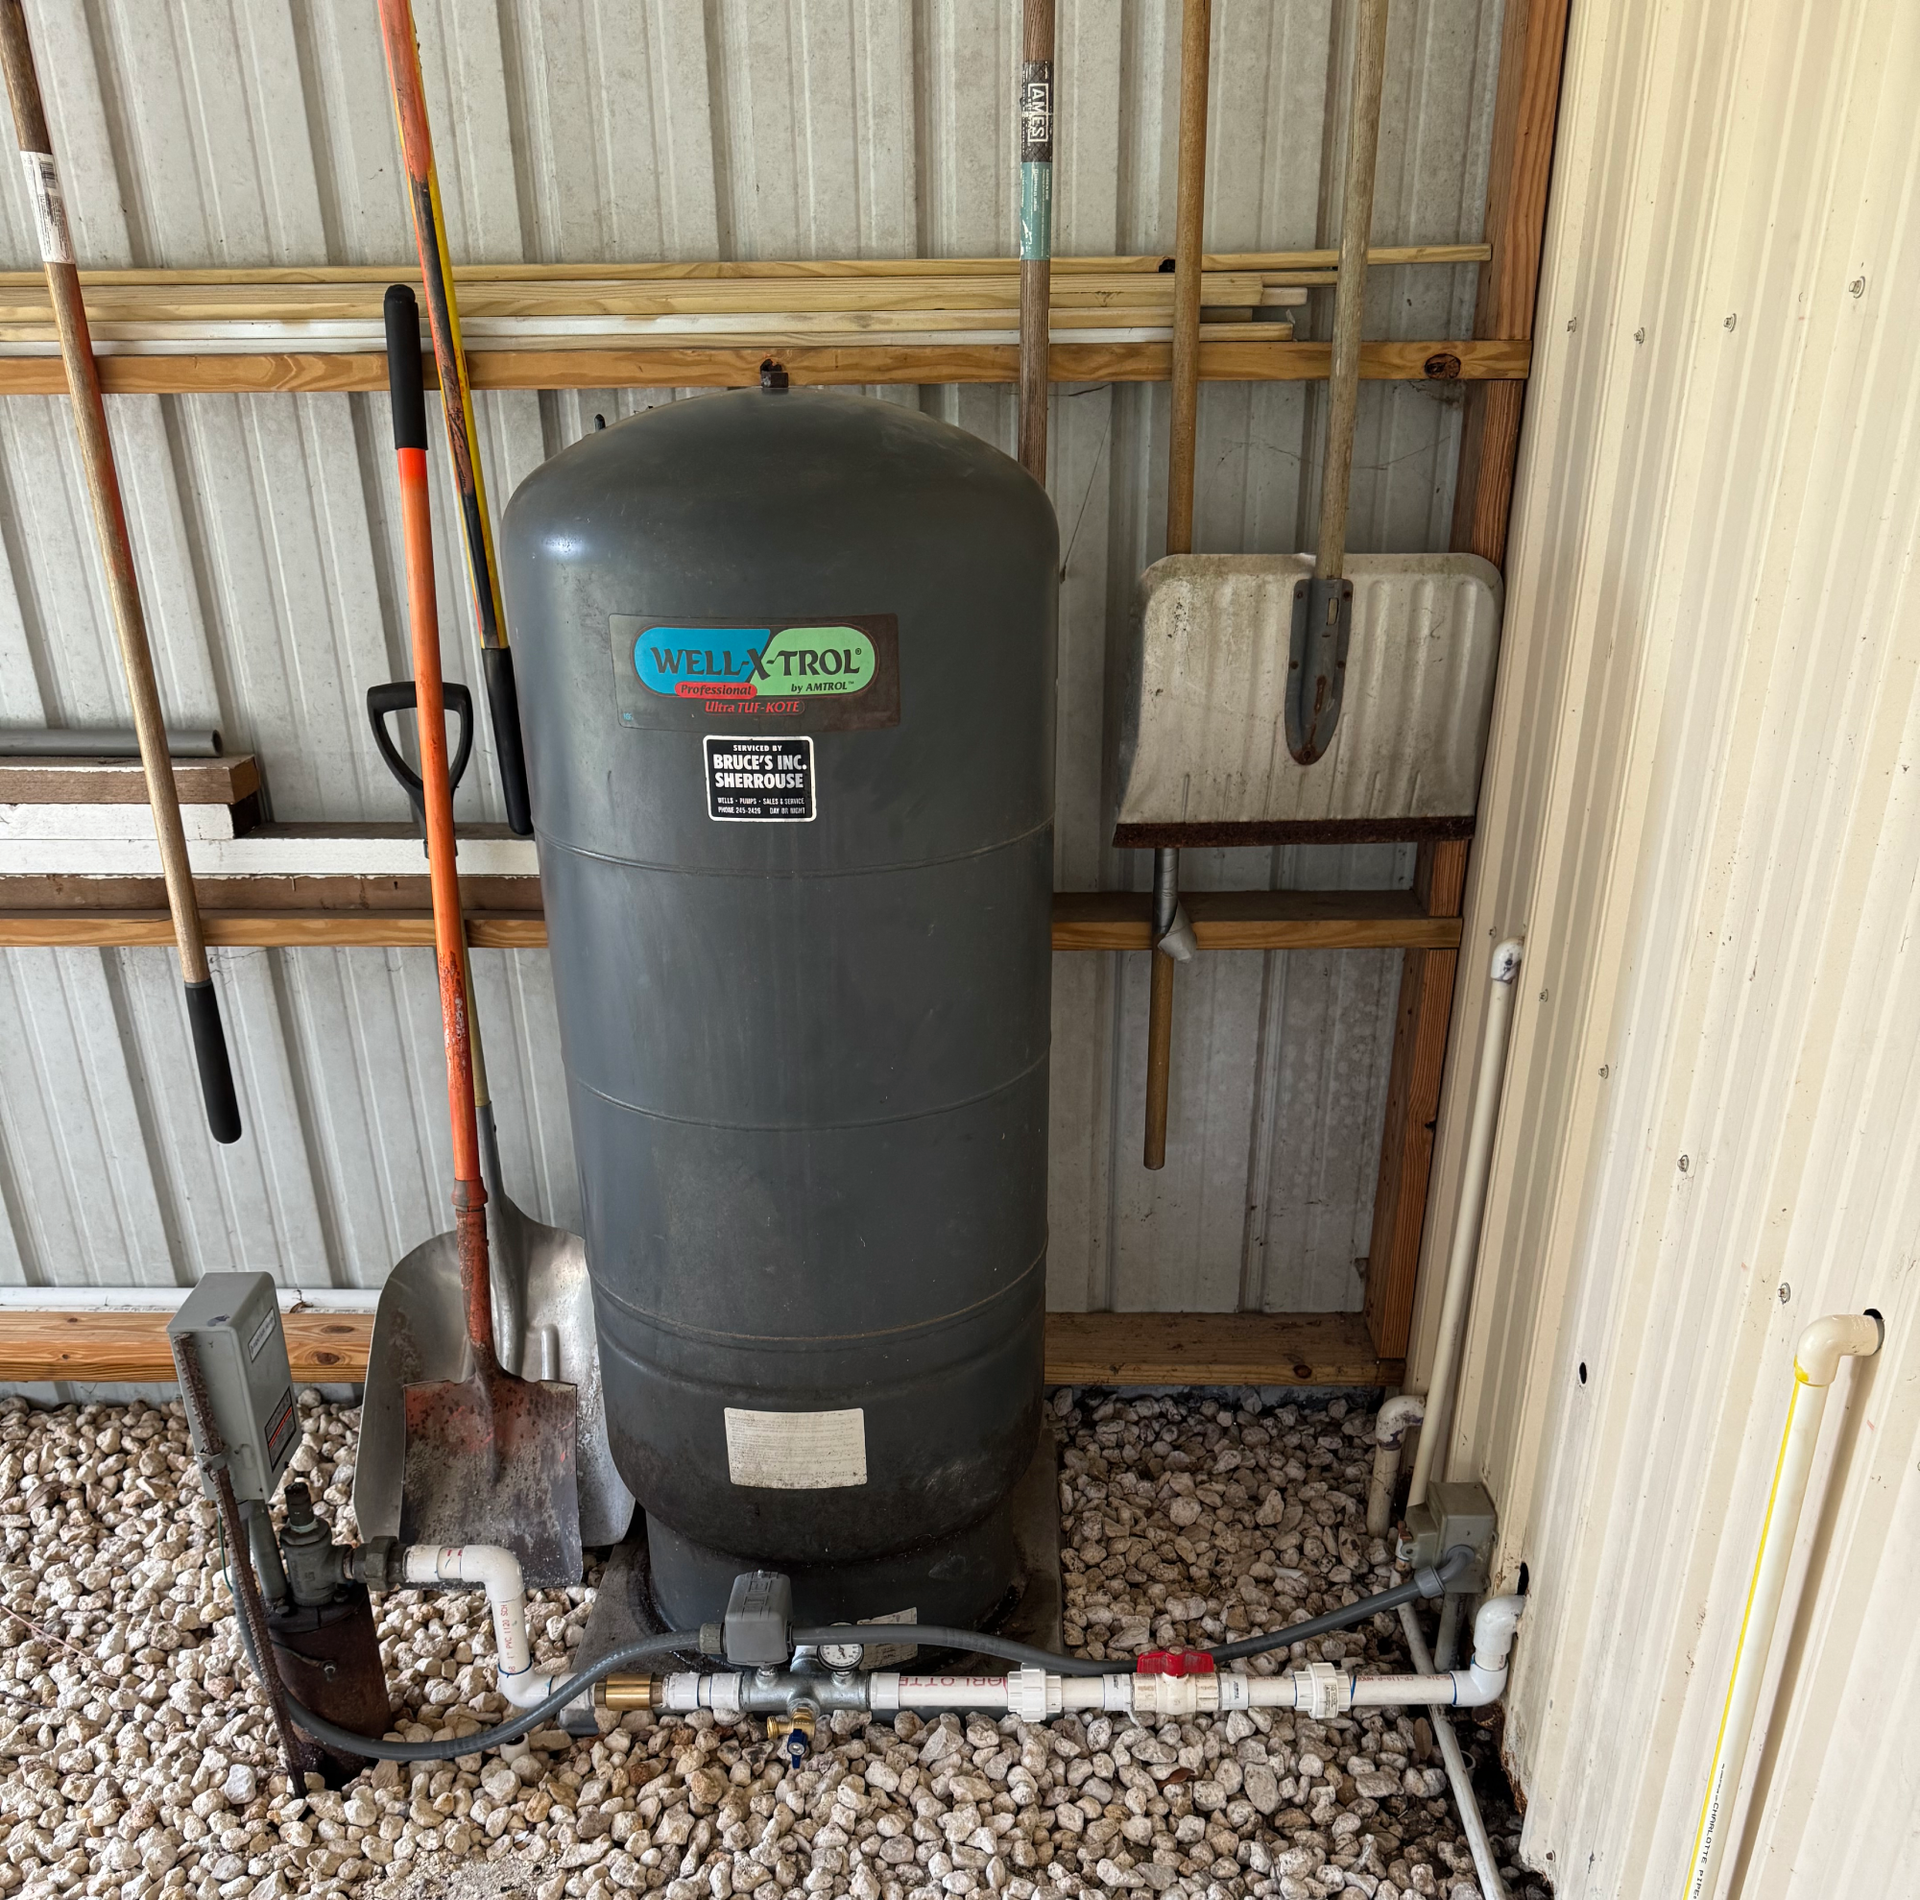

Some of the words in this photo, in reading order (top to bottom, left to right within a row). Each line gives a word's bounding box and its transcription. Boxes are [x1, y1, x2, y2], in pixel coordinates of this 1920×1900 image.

[1031, 87, 1045, 137] AMES
[680, 684, 752, 696] Professional
[791, 683, 802, 693] by
[704, 701, 735, 713] Ultra
[737, 701, 800, 714] TUF-KOTE
[733, 744, 770, 752] SERVICED
[713, 754, 774, 770] BRUCE'S
[777, 754, 808, 770] INC.
[714, 772, 804, 789] SHERROUSE
[739, 797, 757, 805] PUMPS
[762, 797, 779, 805] SALES
[784, 797, 805, 805] SERVICE
[717, 806, 735, 814] PHONE
[502, 1619, 511, 1634] 1120
[504, 1637, 514, 1649] PVC
[1701, 1802, 1719, 1864] CHARLOTTE
